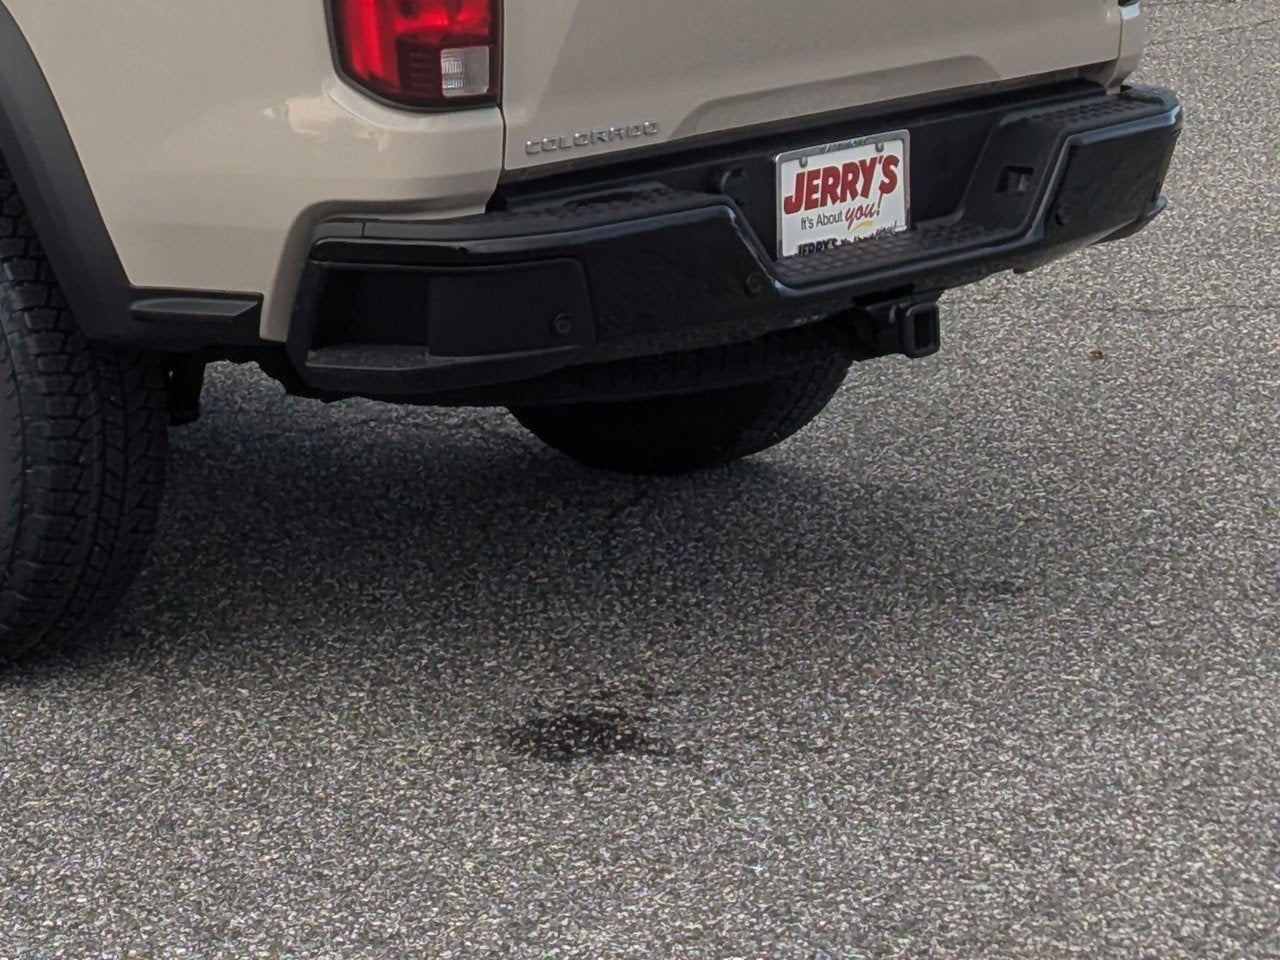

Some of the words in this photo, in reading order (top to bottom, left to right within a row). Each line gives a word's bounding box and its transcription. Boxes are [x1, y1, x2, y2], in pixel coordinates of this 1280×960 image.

[525, 120, 660, 155] COLORADO
[783, 154, 900, 215] JERRY'S
[801, 216, 814, 231] It's
[816, 211, 843, 228] About
